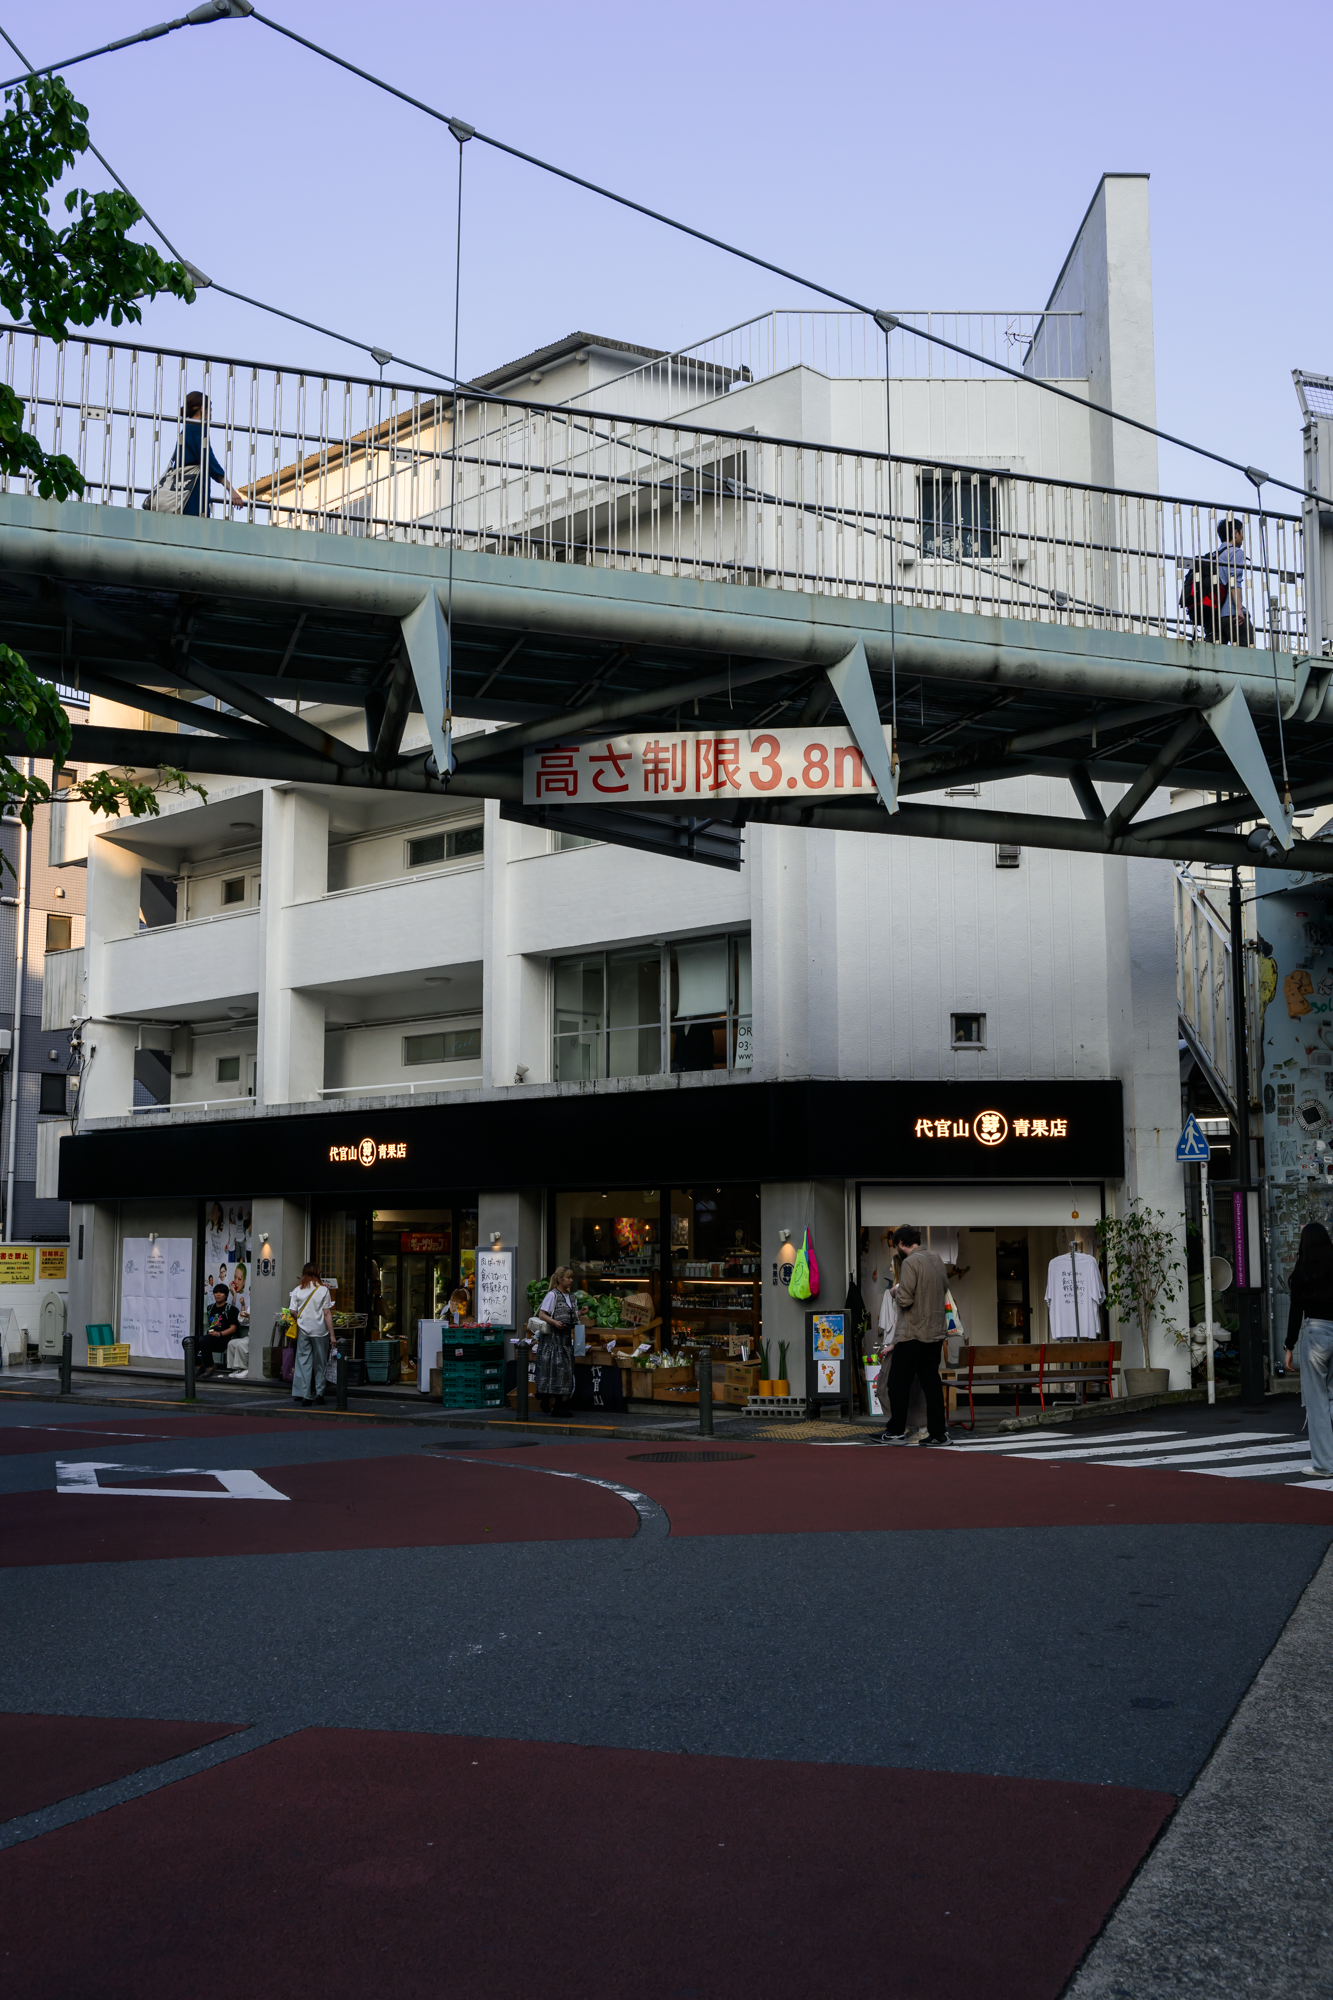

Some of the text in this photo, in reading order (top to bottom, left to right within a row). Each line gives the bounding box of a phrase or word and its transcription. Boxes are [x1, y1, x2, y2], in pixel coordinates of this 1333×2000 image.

[914, 1118, 970, 1138] 代官山
[1012, 1118, 1068, 1138] 青果店
[328, 1145, 358, 1162] 代官山
[378, 1142, 408, 1160] 青果店
[590, 1365, 605, 1407] 代官山
